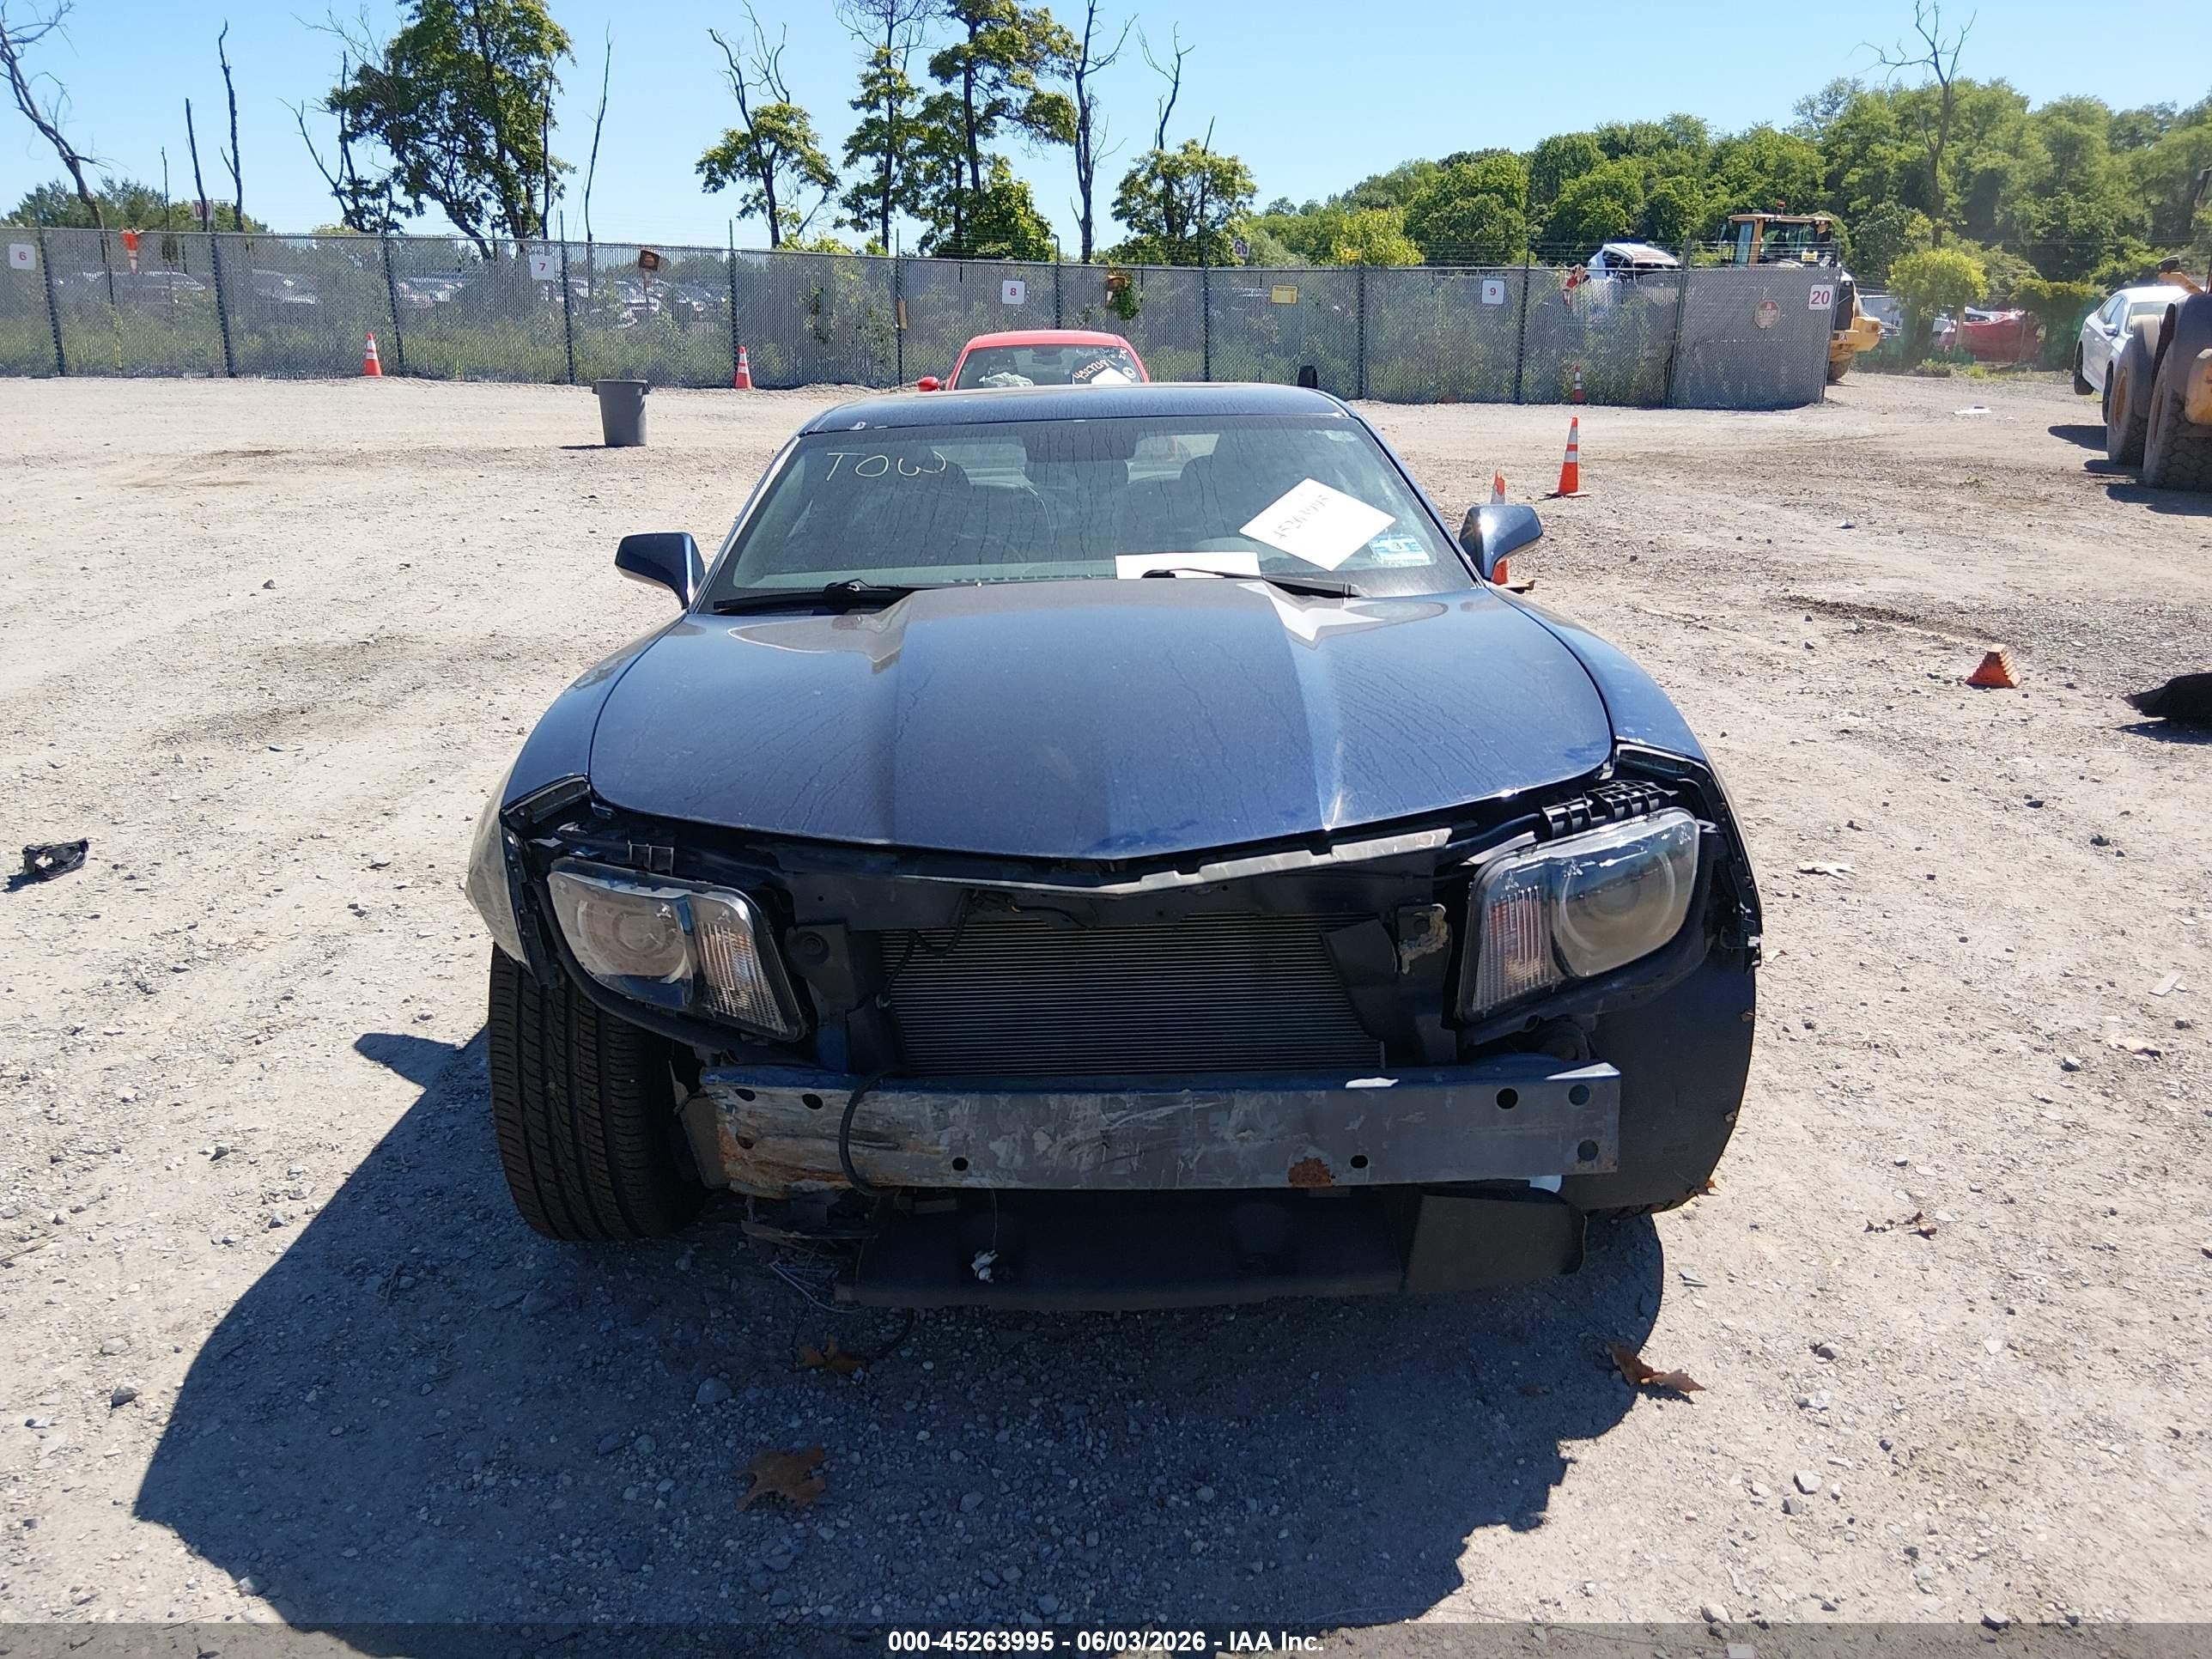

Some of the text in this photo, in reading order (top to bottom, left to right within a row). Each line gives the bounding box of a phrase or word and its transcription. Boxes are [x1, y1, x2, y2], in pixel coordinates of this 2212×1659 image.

[19, 252, 27, 261] 6
[538, 262, 546, 271] 7
[1009, 287, 1018, 296] 8
[1490, 287, 1497, 296] 9
[1810, 290, 1831, 305] 20
[1758, 309, 1778, 319] STOP
[826, 451, 946, 482] TOW
